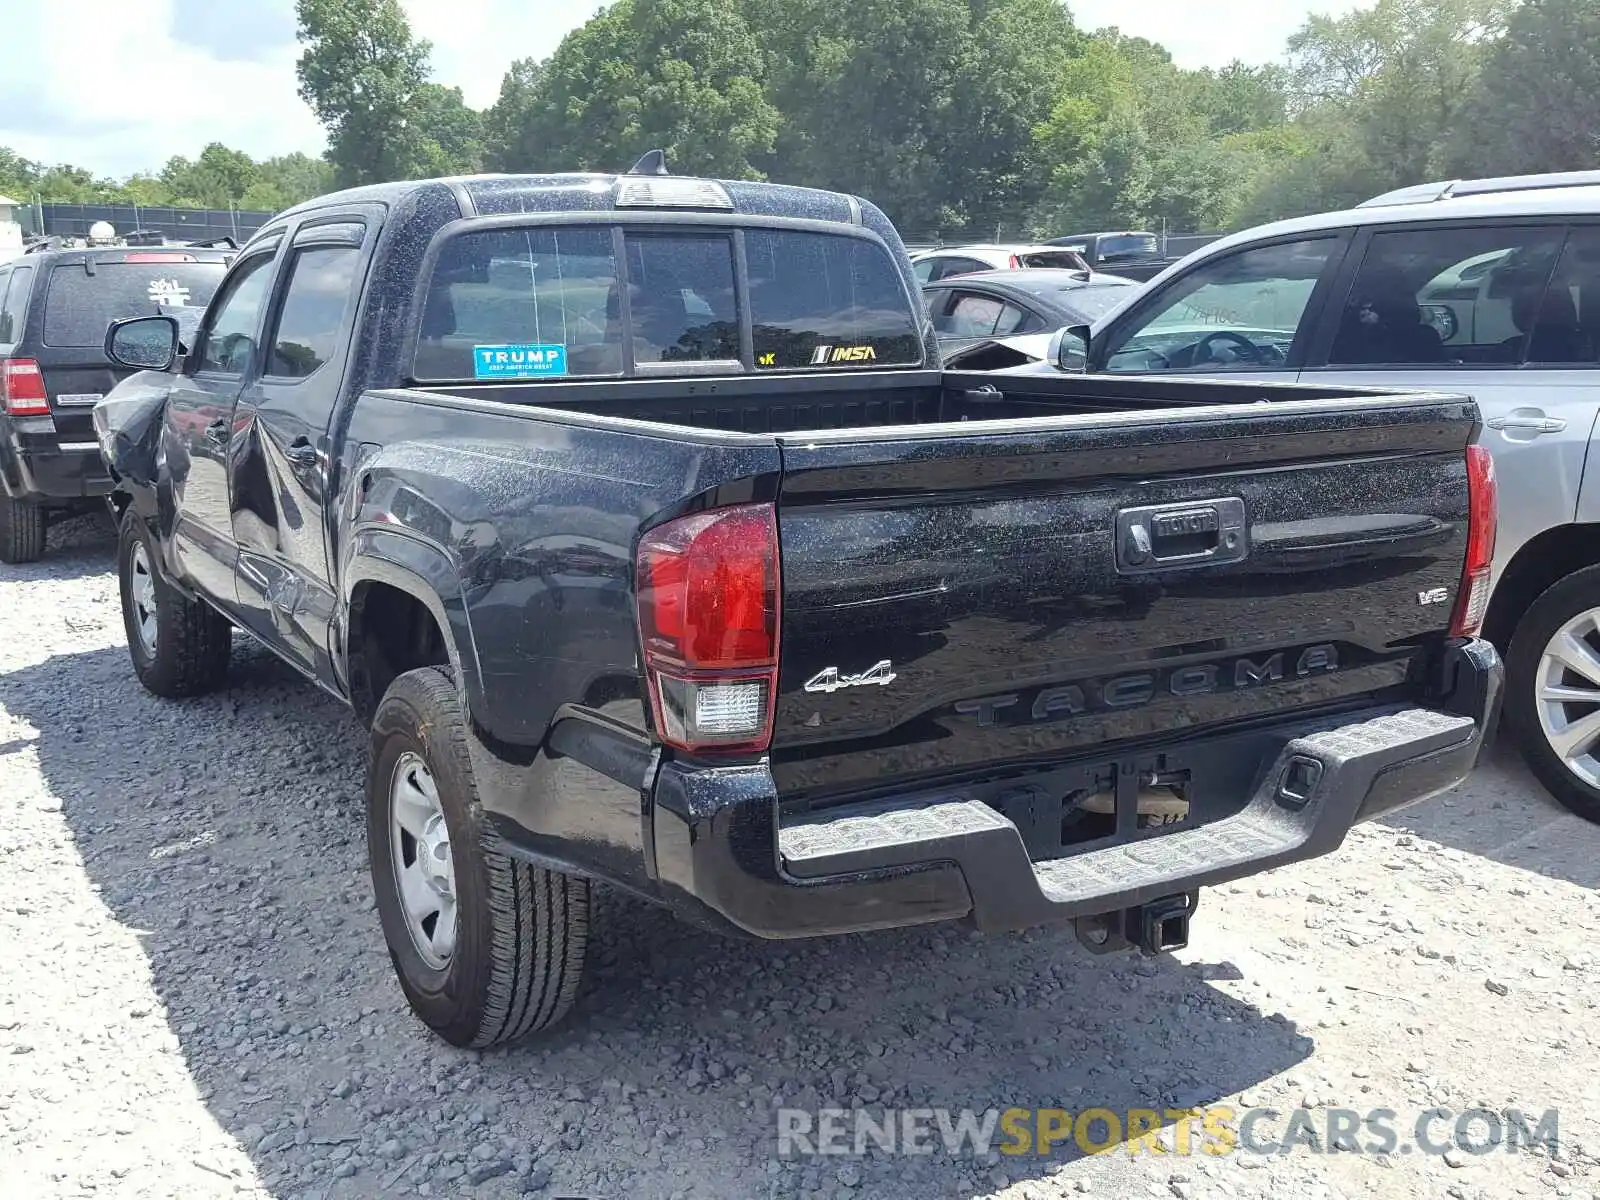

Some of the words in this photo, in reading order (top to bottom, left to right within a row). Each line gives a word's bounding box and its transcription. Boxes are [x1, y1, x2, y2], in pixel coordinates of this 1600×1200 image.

[481, 350, 559, 363] TRUMP
[831, 346, 876, 361] IMSA
[954, 643, 1340, 727] TACOMA
